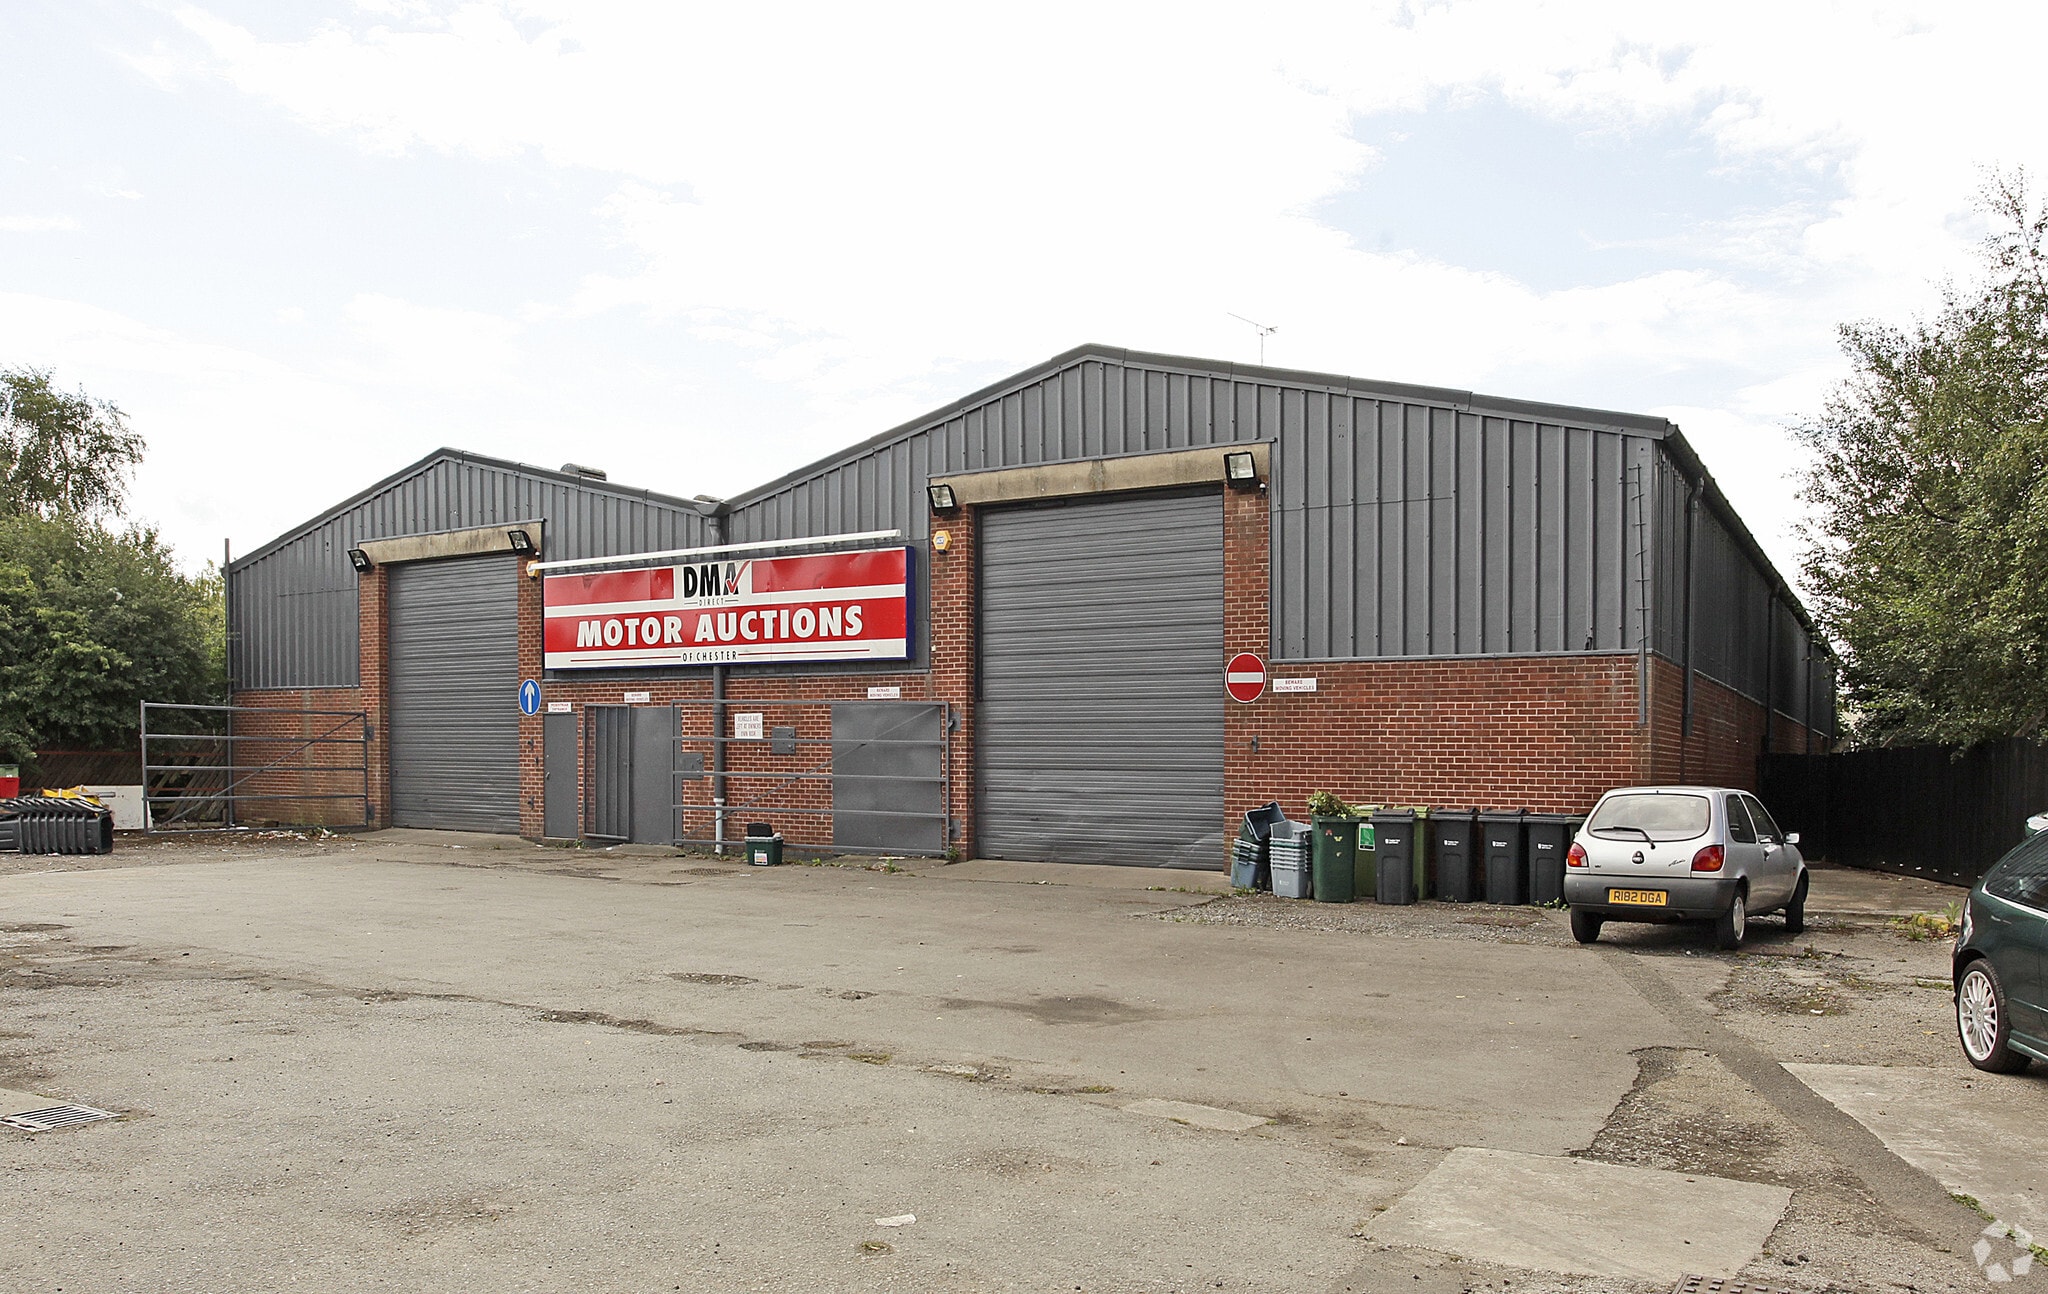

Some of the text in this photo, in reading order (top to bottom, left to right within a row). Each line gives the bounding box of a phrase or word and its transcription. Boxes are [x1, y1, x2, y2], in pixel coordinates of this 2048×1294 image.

[699, 598, 724, 606] DIRECT
[576, 605, 863, 648] MOTOR AUCTIONS
[682, 650, 737, 662] OF CHESTER
[1613, 890, 1662, 903] R182 DGA
